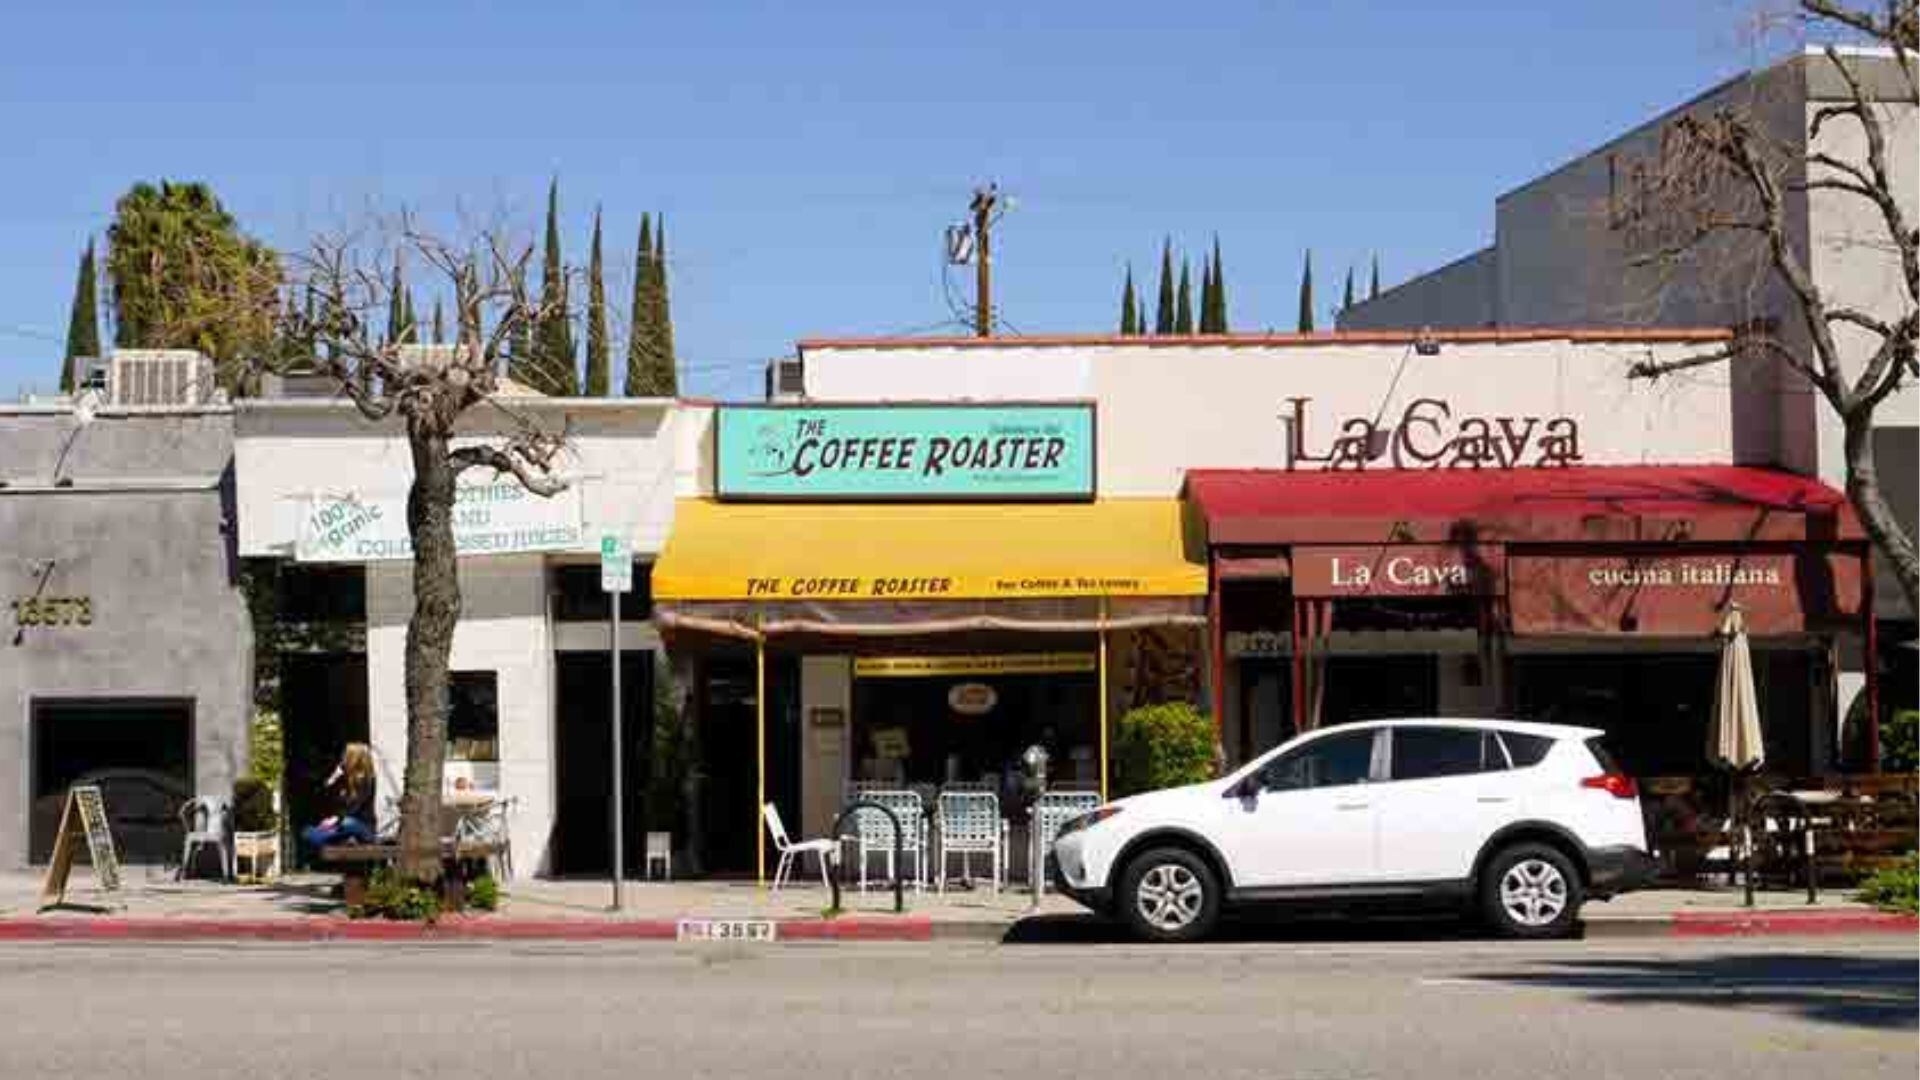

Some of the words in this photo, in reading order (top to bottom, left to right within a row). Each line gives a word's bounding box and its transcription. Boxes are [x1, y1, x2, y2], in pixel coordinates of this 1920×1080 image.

[796, 418, 827, 439] THE
[1285, 397, 1377, 461] La
[1400, 397, 1582, 461] Cava
[792, 437, 918, 477] COFFEE
[923, 436, 1065, 477] ROASTER
[456, 484, 526, 503] OTHIES
[456, 532, 509, 549] SSED
[1331, 558, 1371, 586] La
[1387, 558, 1468, 586] Cava
[1588, 564, 1673, 586] cucina
[1681, 563, 1780, 586] italiana
[747, 578, 781, 596] THE
[791, 578, 860, 596] COFFEE
[872, 578, 951, 596] ROASTER
